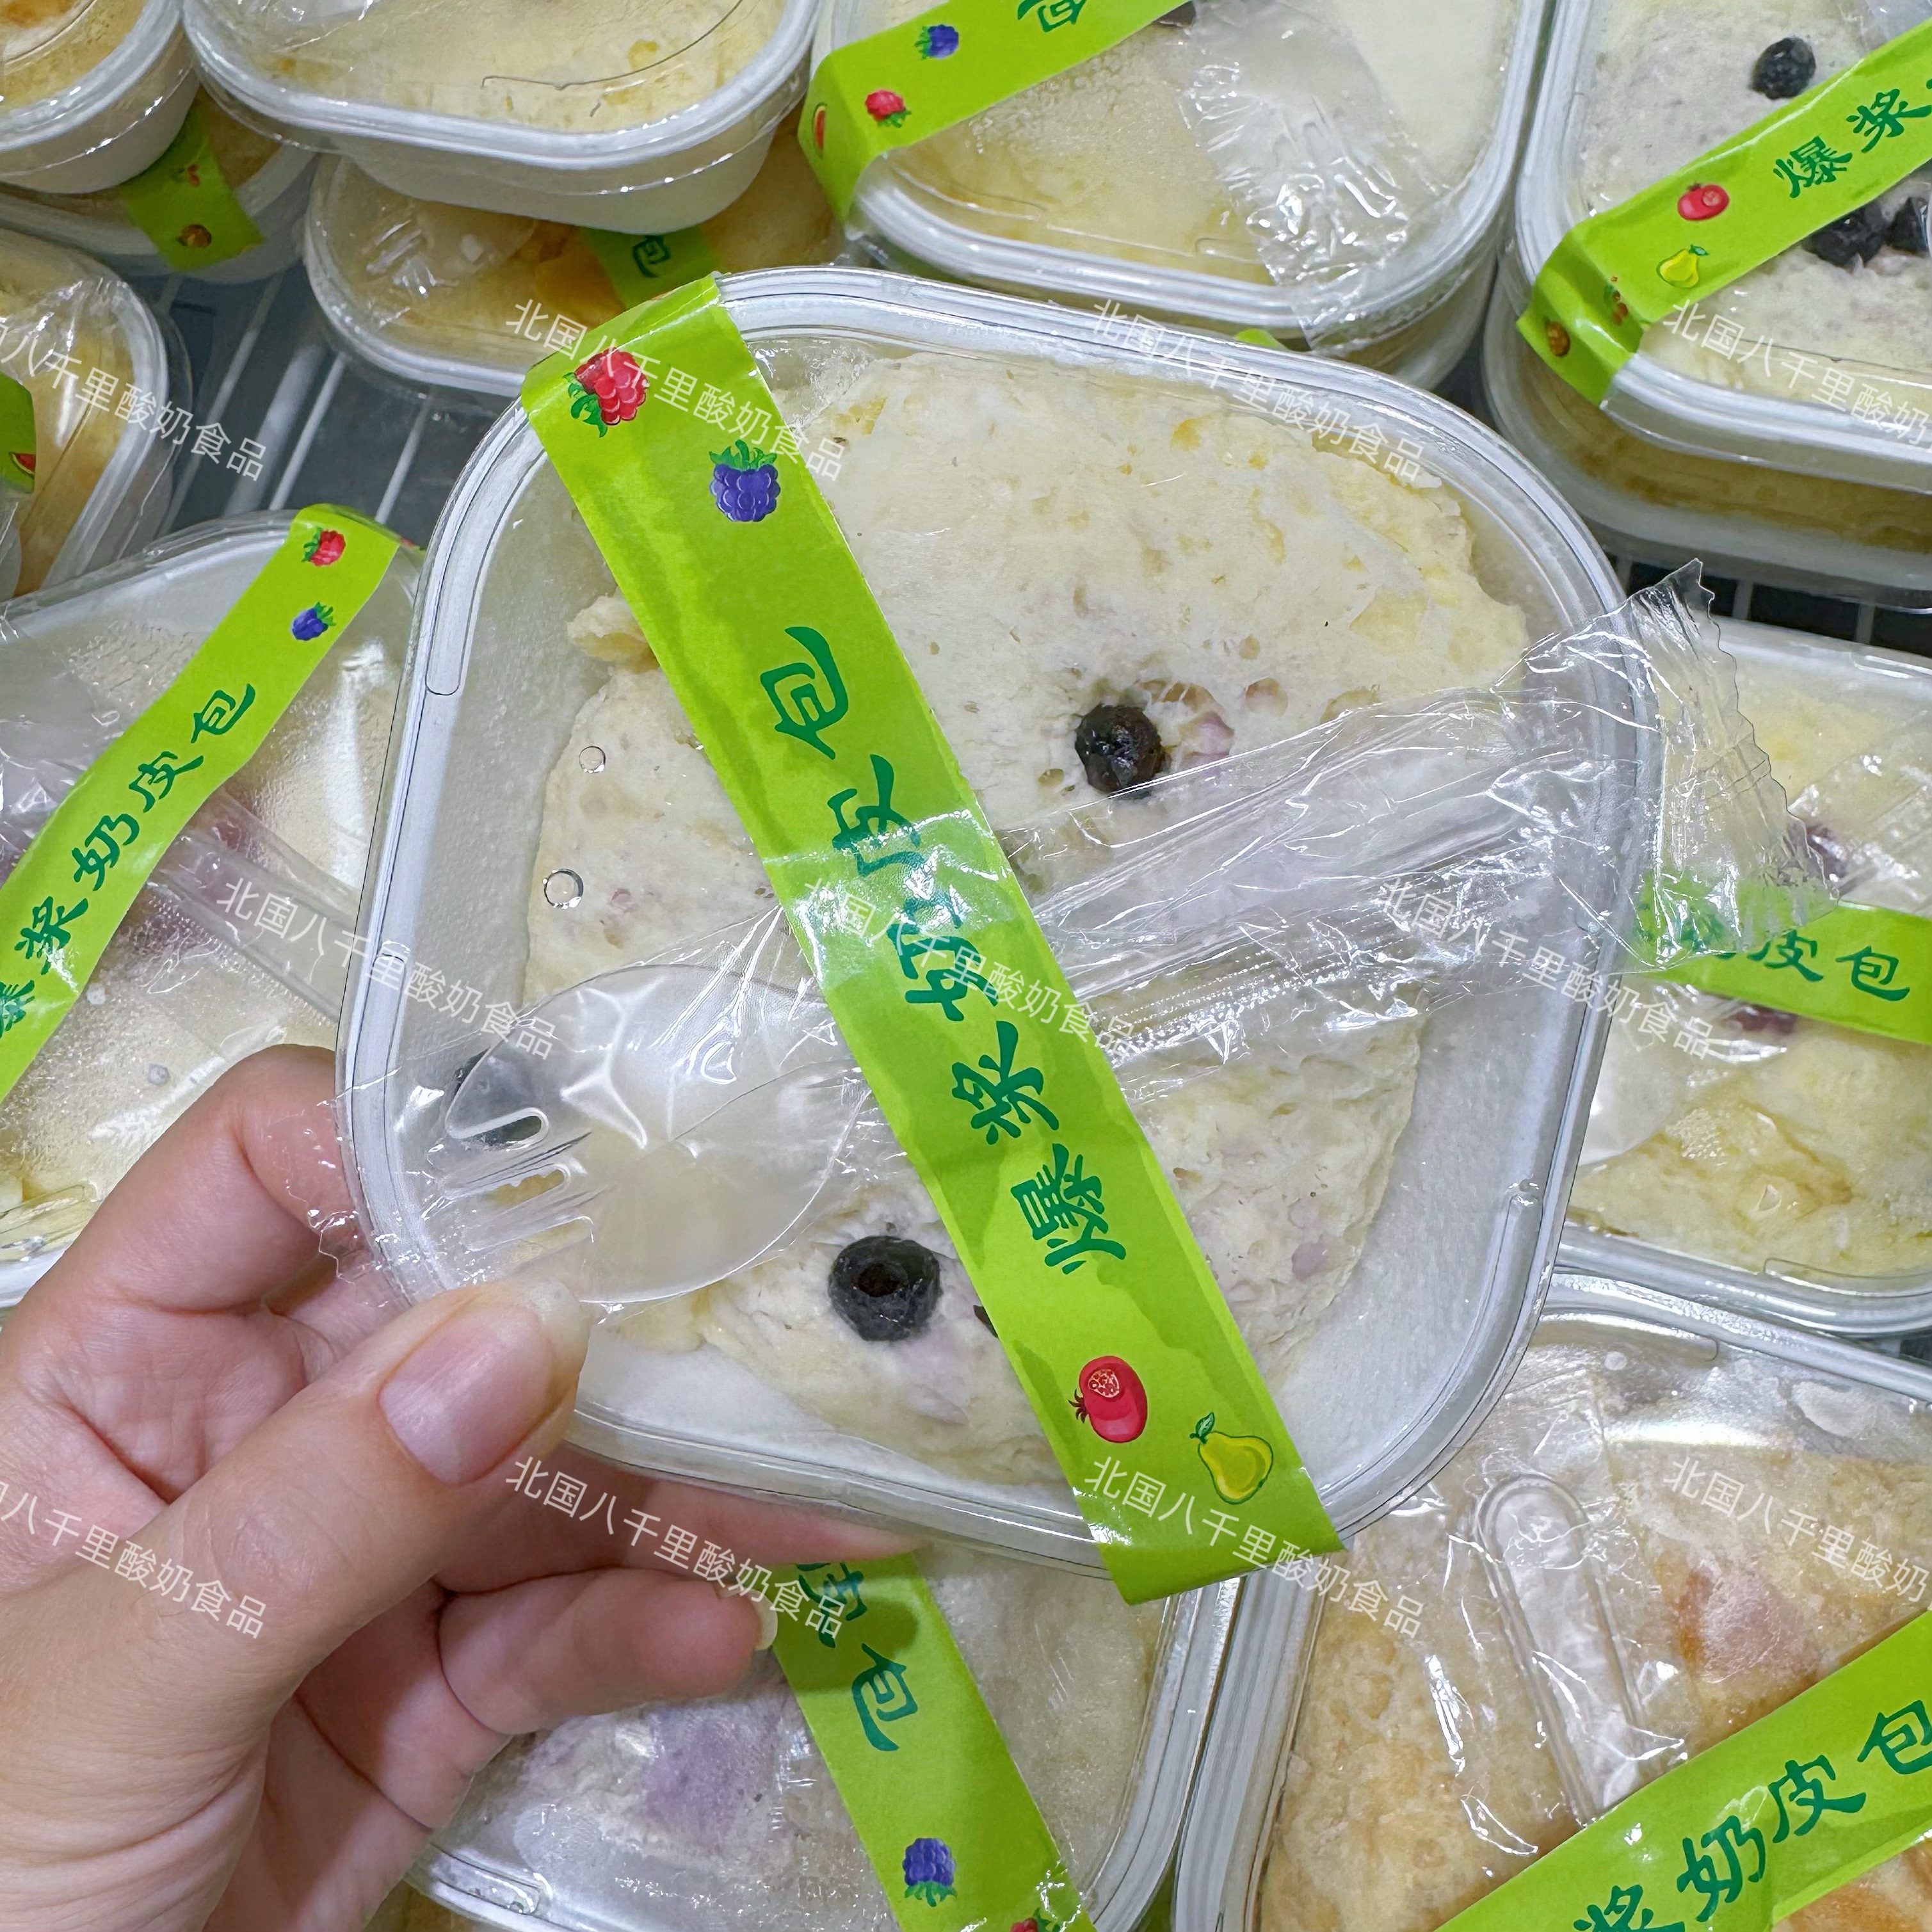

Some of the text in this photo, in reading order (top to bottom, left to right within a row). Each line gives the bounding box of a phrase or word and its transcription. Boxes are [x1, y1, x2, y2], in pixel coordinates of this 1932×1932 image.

[1773, 79, 1932, 198] 爆浆
[759, 626, 1127, 1275] 爆浆奶皮包
